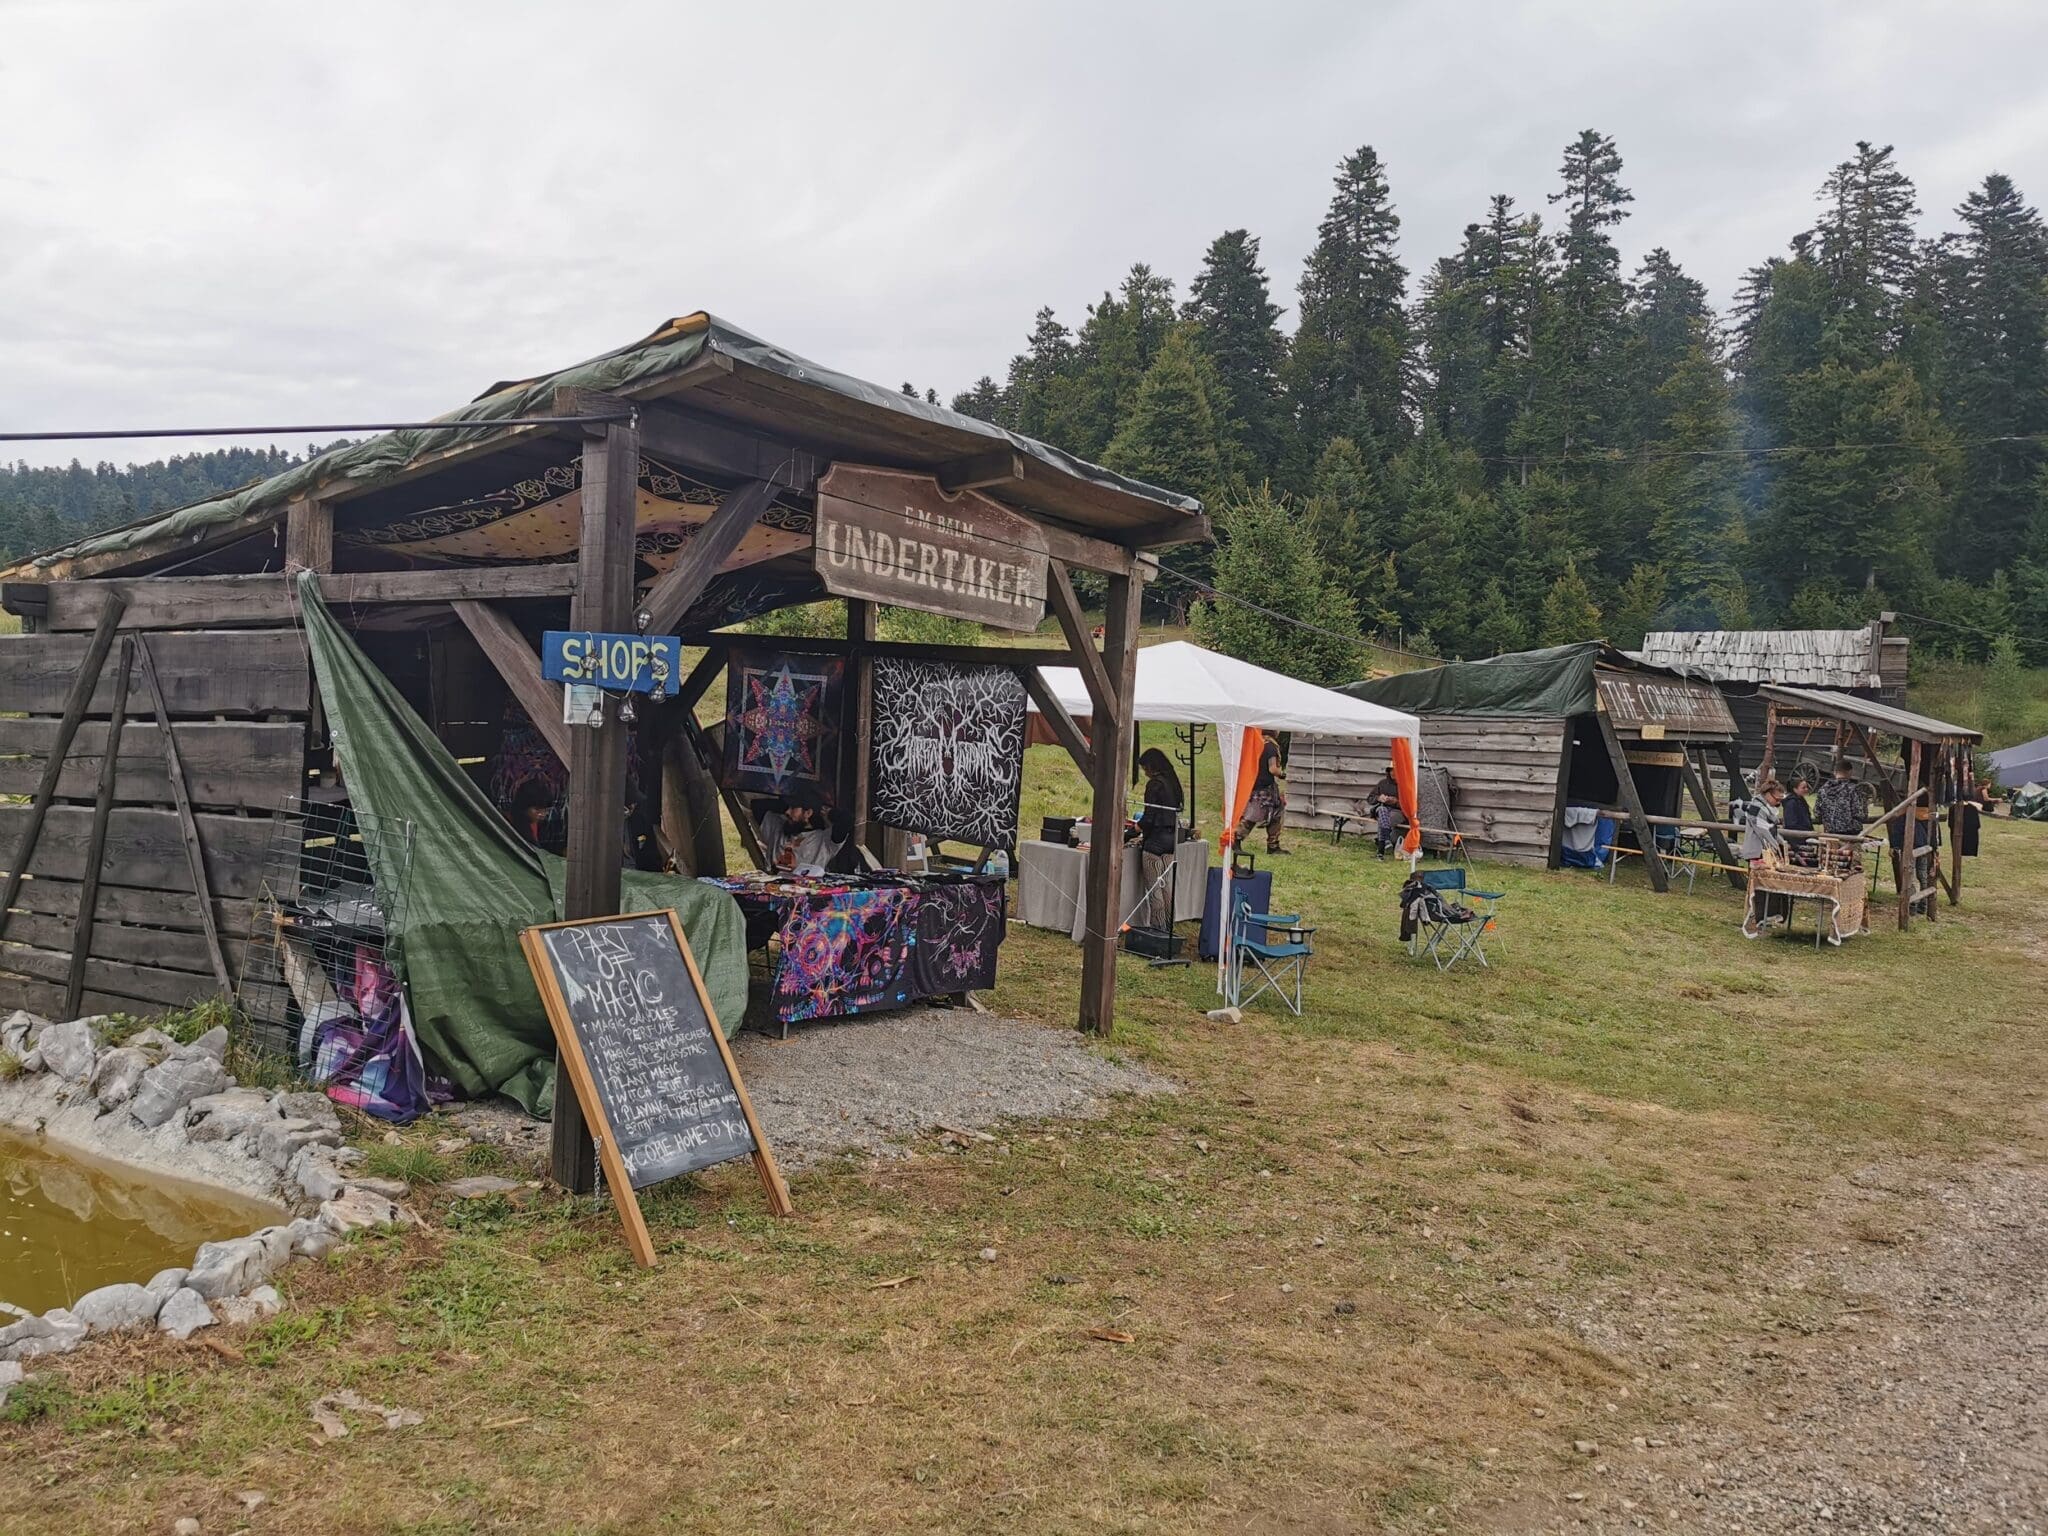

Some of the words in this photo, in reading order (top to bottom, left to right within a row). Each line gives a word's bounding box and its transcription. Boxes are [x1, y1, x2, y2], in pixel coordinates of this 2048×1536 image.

[827, 520, 1033, 609] UNDERTAKER
[562, 638, 669, 681] SHOPS
[1600, 681, 1645, 720] THE
[561, 925, 634, 961] PART
[598, 952, 636, 980] OF
[584, 970, 663, 1018] MAGIC
[591, 1018, 626, 1033] MAGIC
[629, 1006, 679, 1026] CANDLES
[598, 1035, 621, 1049] OIL
[623, 1020, 680, 1042] PERFUME
[603, 1046, 635, 1063] MAGIC
[608, 1071, 648, 1090] PLANT
[650, 1062, 684, 1080] MAGIC
[616, 1087, 652, 1104] WITCH
[621, 1099, 673, 1121] PLAYING
[633, 1137, 673, 1166] COME
[674, 1126, 708, 1153] HOME
[701, 1122, 720, 1138] TO
[721, 1118, 750, 1141] YOU
